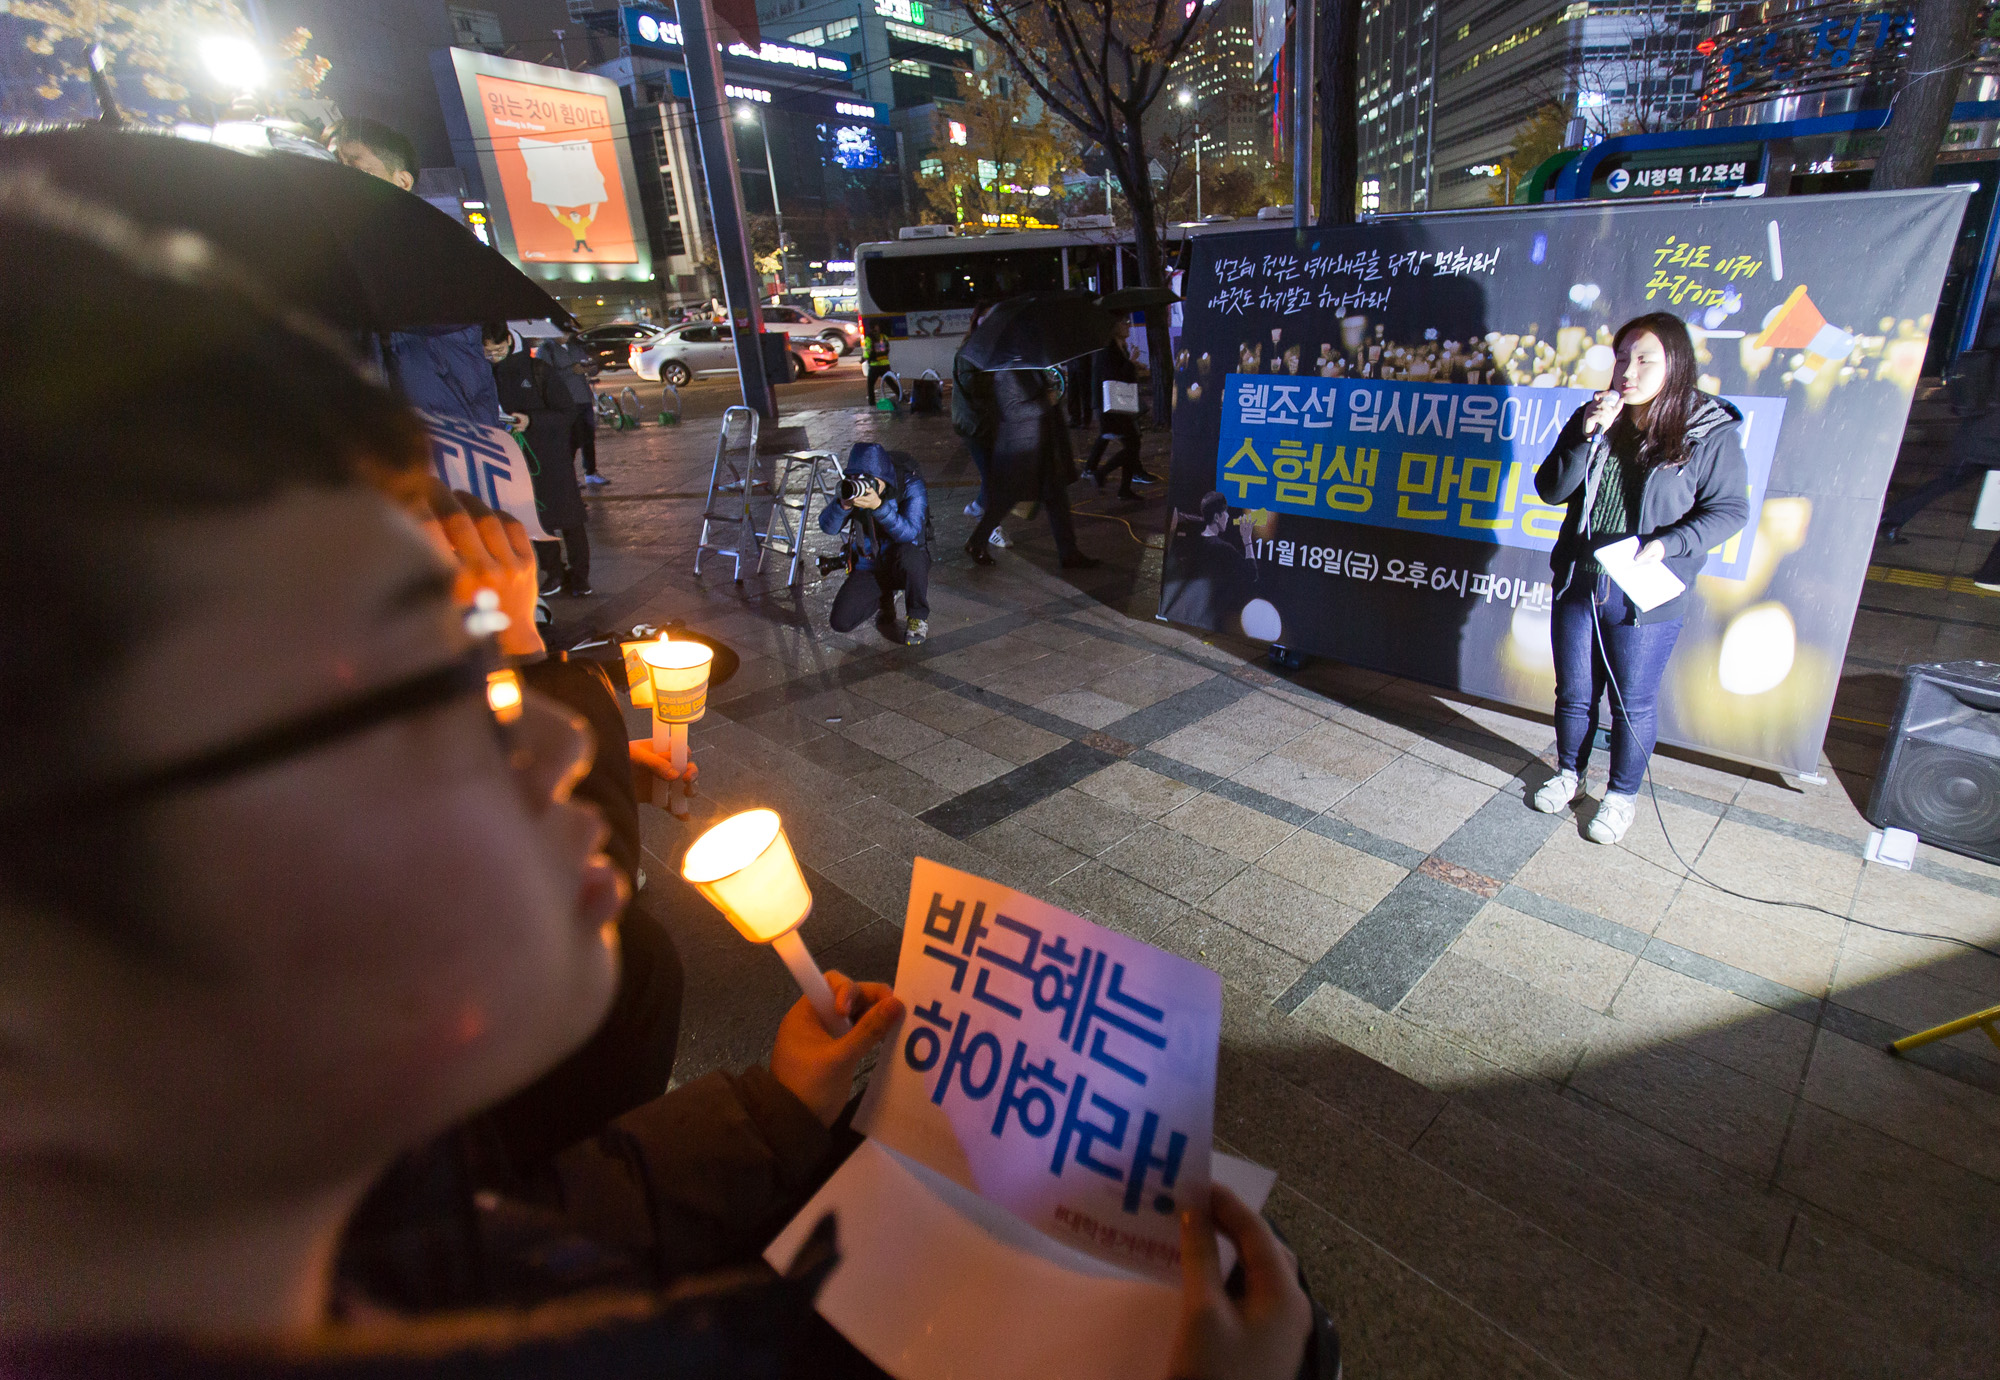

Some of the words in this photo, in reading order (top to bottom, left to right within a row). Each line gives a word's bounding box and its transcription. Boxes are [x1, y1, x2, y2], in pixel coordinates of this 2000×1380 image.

[488, 92, 523, 118] 읽는
[525, 98, 558, 123] 것이
[560, 103, 605, 128] 힘이다
[494, 117, 521, 130] Reading
[1634, 167, 1683, 188] 시청역
[1689, 162, 1746, 184] 1,2호선
[1215, 256, 1255, 284] 박근혜
[1262, 254, 1300, 284] 정부는
[1304, 249, 1383, 282] 역사왜곡을
[1387, 249, 1432, 277] 당장
[1433, 245, 1500, 277] 멈춰라!
[1653, 235, 1711, 268] 우리도
[1713, 255, 1763, 281] 이제
[1208, 286, 1255, 316] 아무것도
[1258, 285, 1312, 316] 하지말고
[1318, 283, 1392, 312] 하야하라!
[1645, 270, 1743, 321] 광장이다!
[1238, 383, 1337, 429] 헬조선
[1223, 437, 1380, 514] 수험생
[1254, 537, 1296, 567] 11월
[1299, 544, 1379, 582] 18일(금)
[1382, 558, 1429, 589] 오후
[1430, 566, 1469, 598] 6시
[922, 892, 1168, 1088] 박근혜는
[904, 999, 1188, 1216] 하야하라!
